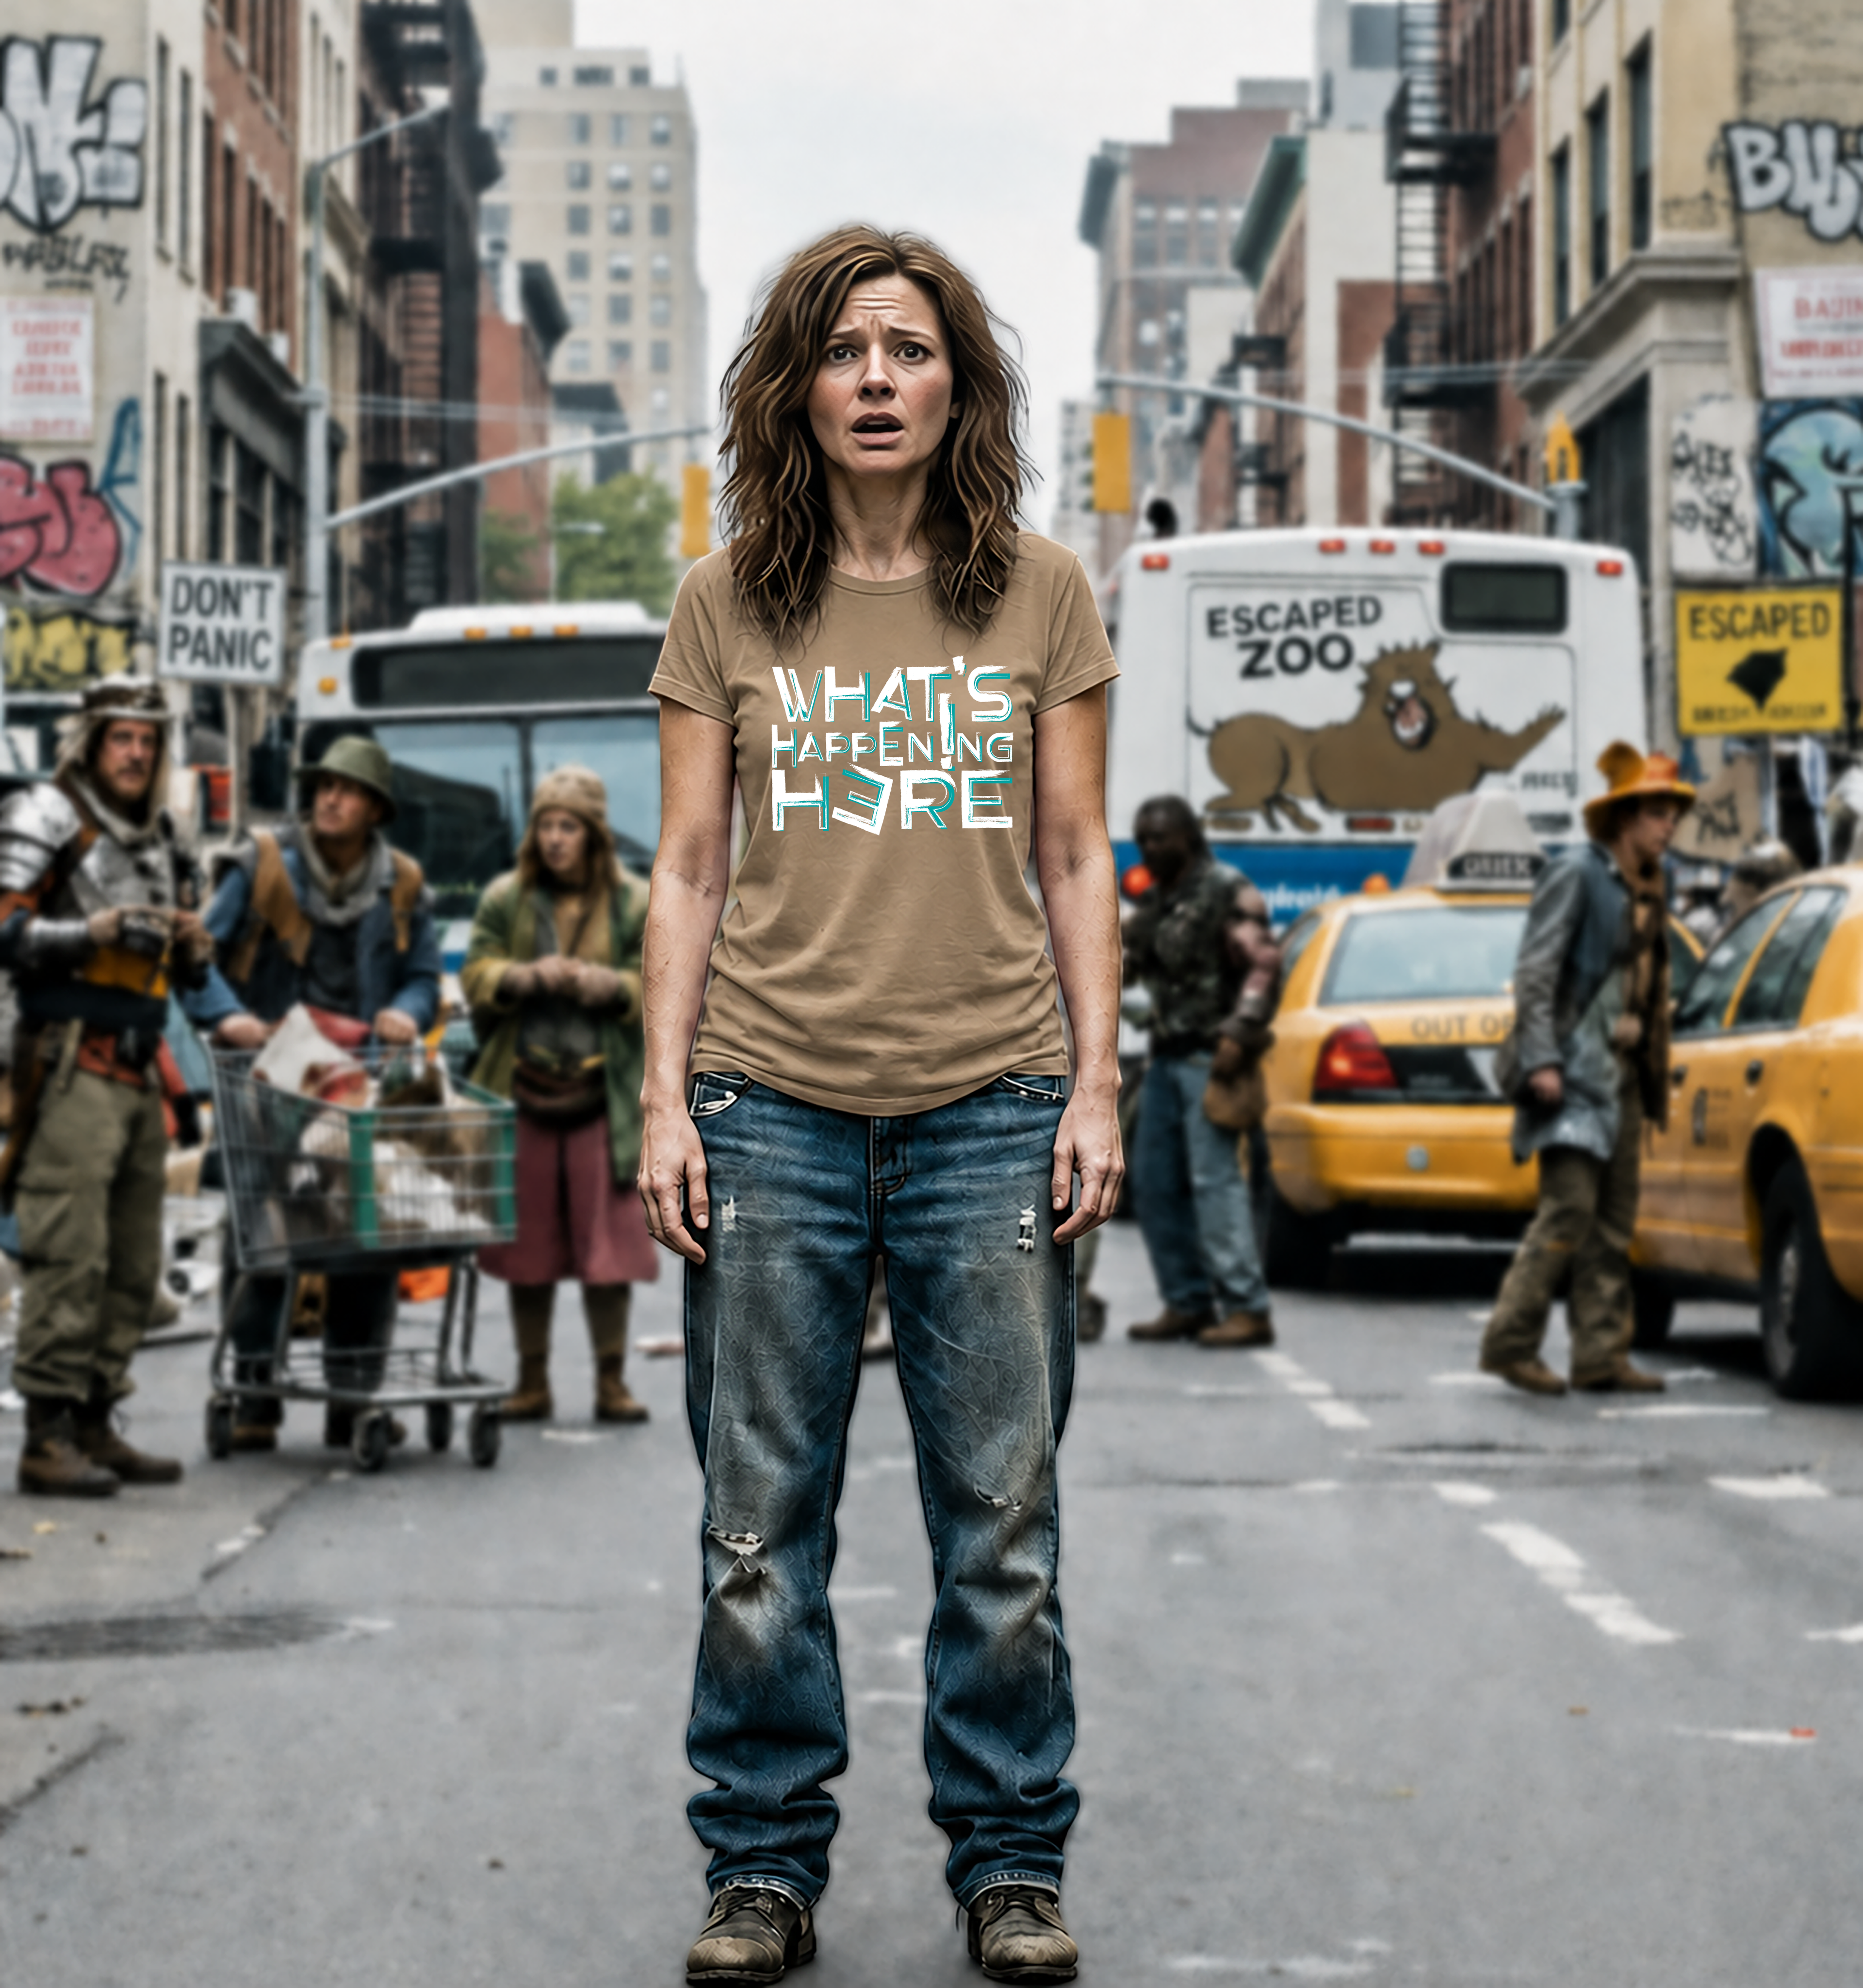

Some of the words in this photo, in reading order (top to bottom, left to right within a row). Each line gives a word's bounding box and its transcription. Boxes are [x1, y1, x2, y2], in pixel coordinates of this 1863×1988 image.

[171, 575, 275, 621] DON'T
[1206, 595, 1382, 639] ESCAPED
[1688, 601, 1831, 643] ESCAPED
[167, 624, 272, 671] PANIC
[1236, 633, 1355, 679] ZOO
[772, 655, 1013, 722] WHAT'S
[771, 762, 1013, 836] HERE
[1410, 1013, 1468, 1041] OUT
